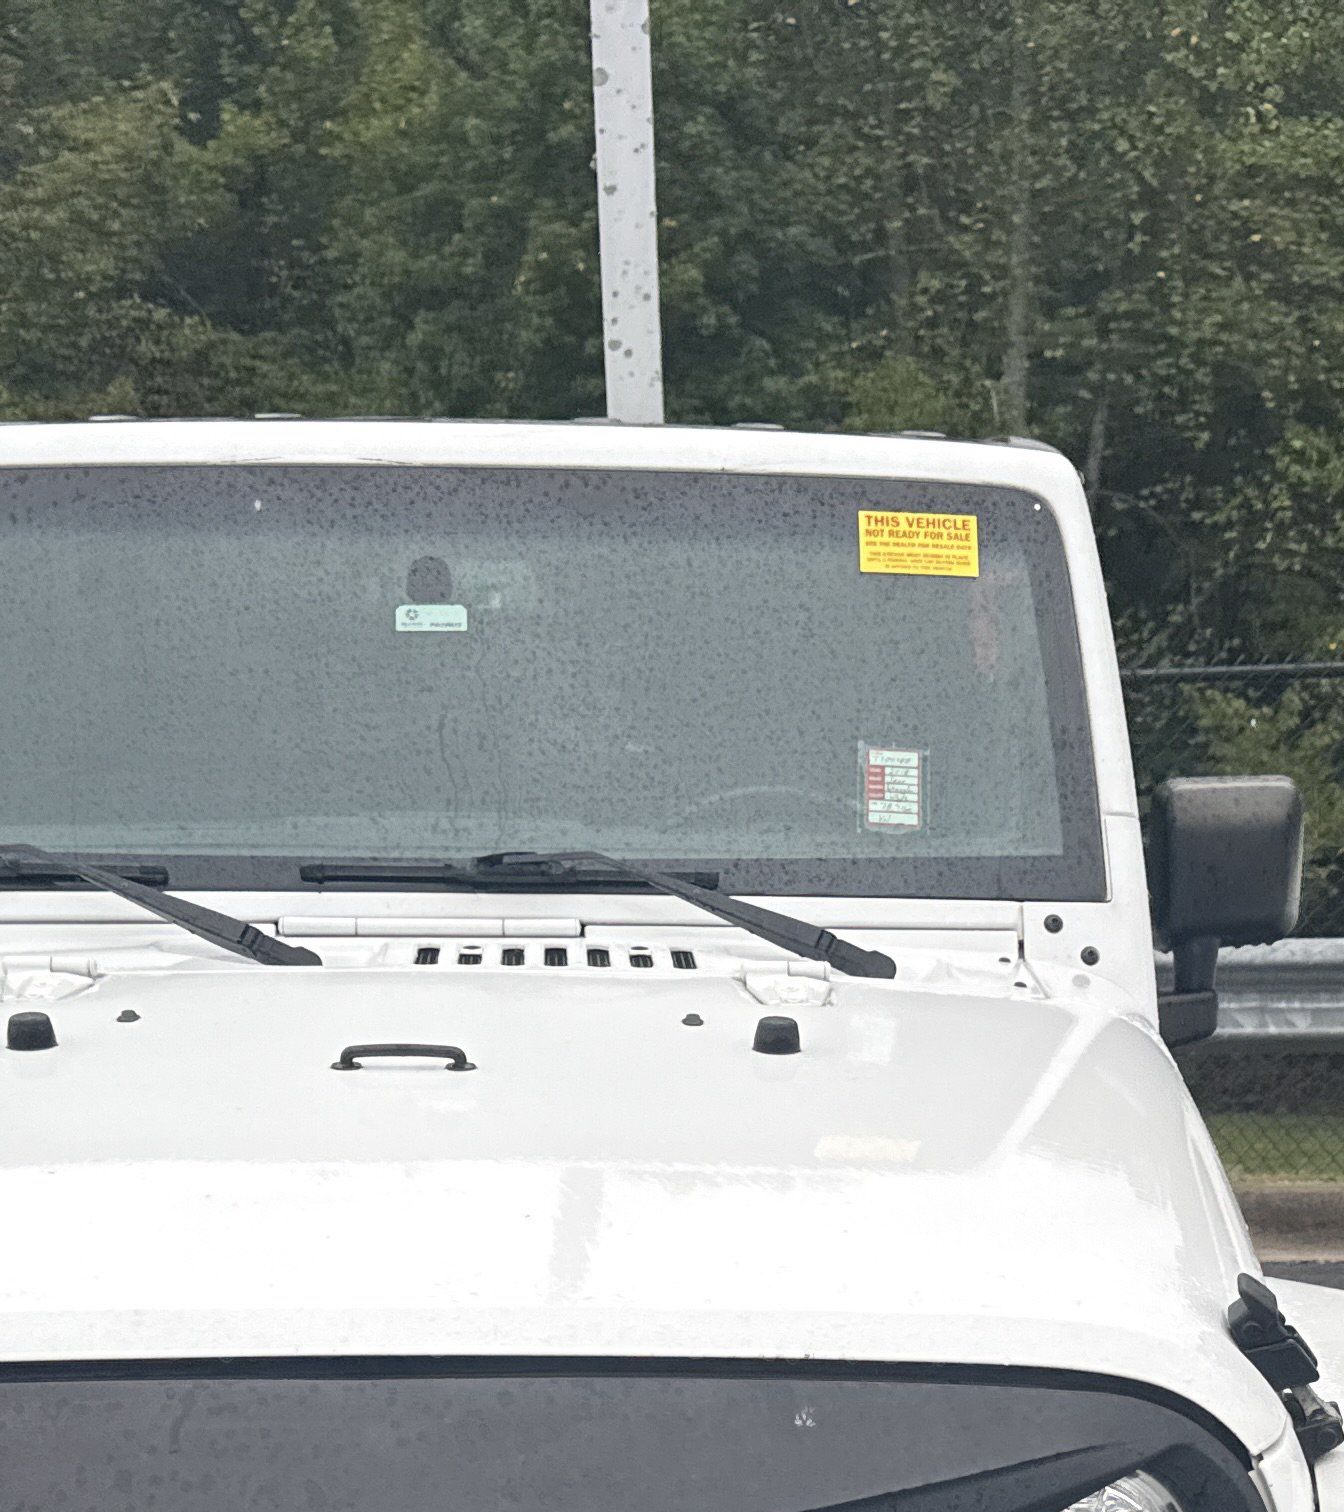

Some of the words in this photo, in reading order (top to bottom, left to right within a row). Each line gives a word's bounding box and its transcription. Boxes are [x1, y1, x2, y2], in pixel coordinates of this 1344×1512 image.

[864, 514, 900, 528] THIS
[905, 516, 971, 531] VEHICLE
[865, 529, 885, 538] NOT
[888, 529, 921, 540] READY
[924, 531, 944, 540] FOR
[946, 532, 971, 542] SALE
